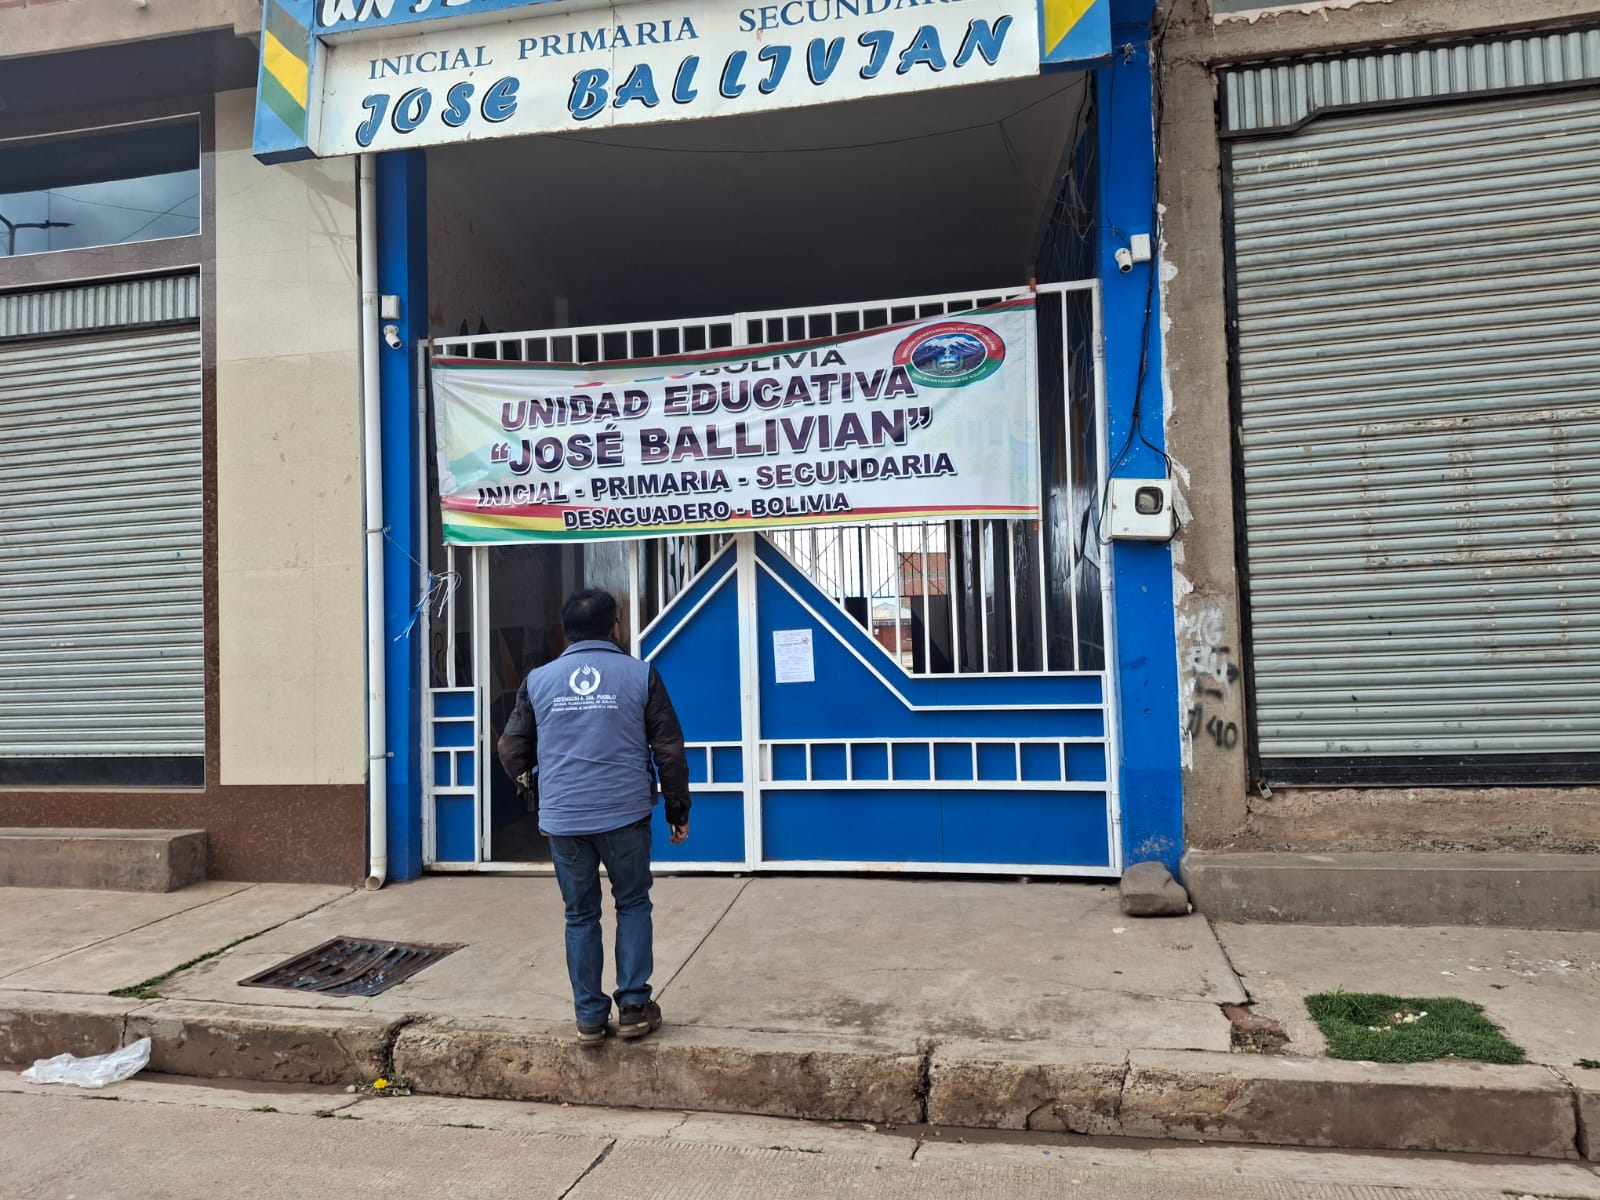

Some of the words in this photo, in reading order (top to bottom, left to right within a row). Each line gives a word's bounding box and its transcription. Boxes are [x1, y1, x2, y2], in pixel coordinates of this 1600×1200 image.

[368, 45, 493, 80] INICIAL
[518, 16, 699, 60] PRIMARIA
[567, 14, 1014, 121] BALLIVIAN
[500, 387, 651, 432] UNIDAD
[663, 364, 918, 416] EDUCATIVA
[490, 423, 625, 475] “JOSÉ
[639, 405, 933, 465] BALLIVIAN”
[476, 480, 569, 508] INICIAL
[591, 468, 732, 499] PRIMARIA
[755, 452, 958, 489] SECUNDARIA
[562, 501, 732, 530] DESAGUADERO
[751, 492, 853, 518] BOLIVIA
